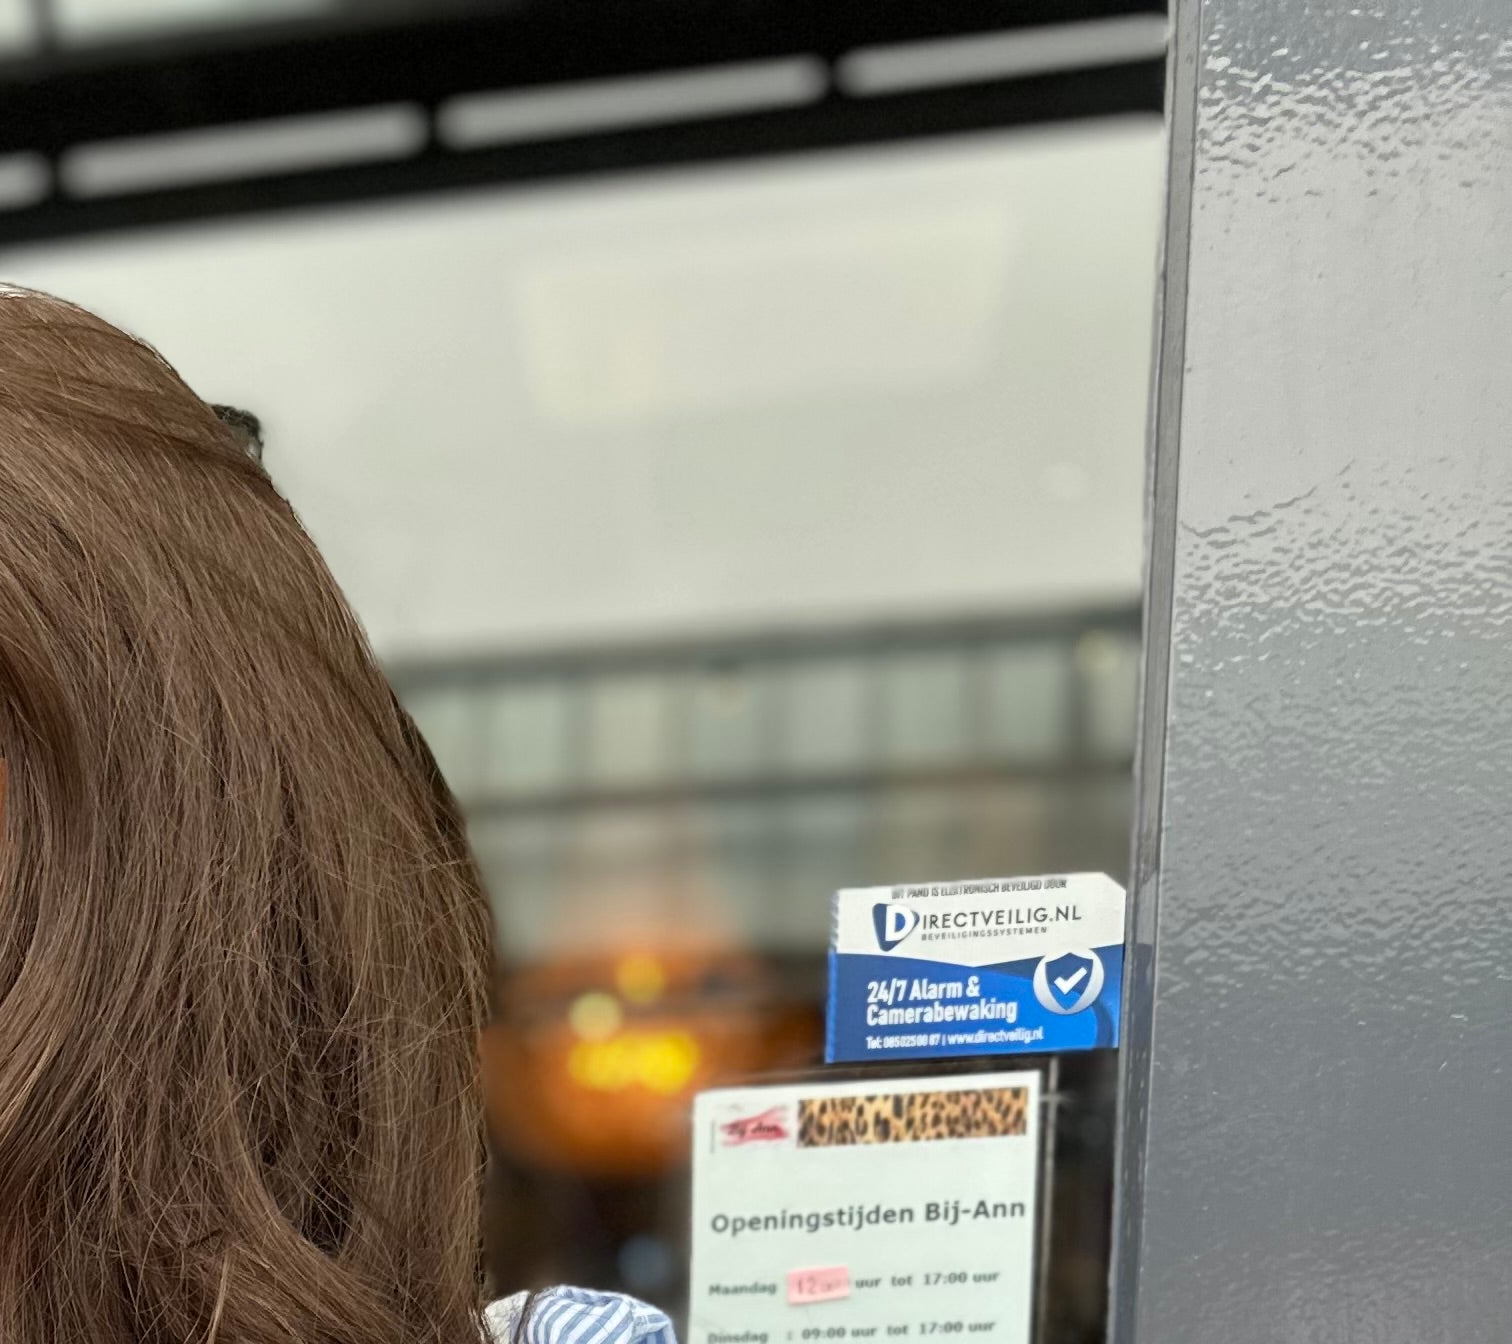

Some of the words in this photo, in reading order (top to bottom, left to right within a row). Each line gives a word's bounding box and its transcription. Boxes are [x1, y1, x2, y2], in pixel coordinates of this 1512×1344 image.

[906, 886, 929, 898] PAND
[931, 885, 939, 896] IS
[921, 926, 1048, 941] BEVEILIGINGSSYSTEMEN
[867, 978, 907, 1005] 24/7
[909, 978, 963, 1001] Alarm
[966, 975, 980, 998] &
[866, 997, 1018, 1026] Camerabewaking
[947, 1025, 1045, 1045] www.directveilig.nl
[711, 1205, 915, 1238] Openingstijden
[925, 1199, 1025, 1226] Bij-Ann
[708, 1280, 777, 1296] Maandag
[855, 1277, 882, 1289] uur
[891, 1275, 913, 1287] tot
[923, 1272, 968, 1286] 17:00
[972, 1270, 1000, 1283] uur
[801, 1327, 846, 1340] 09:00
[850, 1326, 878, 1338] uur
[886, 1324, 909, 1336] tot
[919, 1322, 963, 1336] 17:00
[968, 1320, 996, 1333] uur
